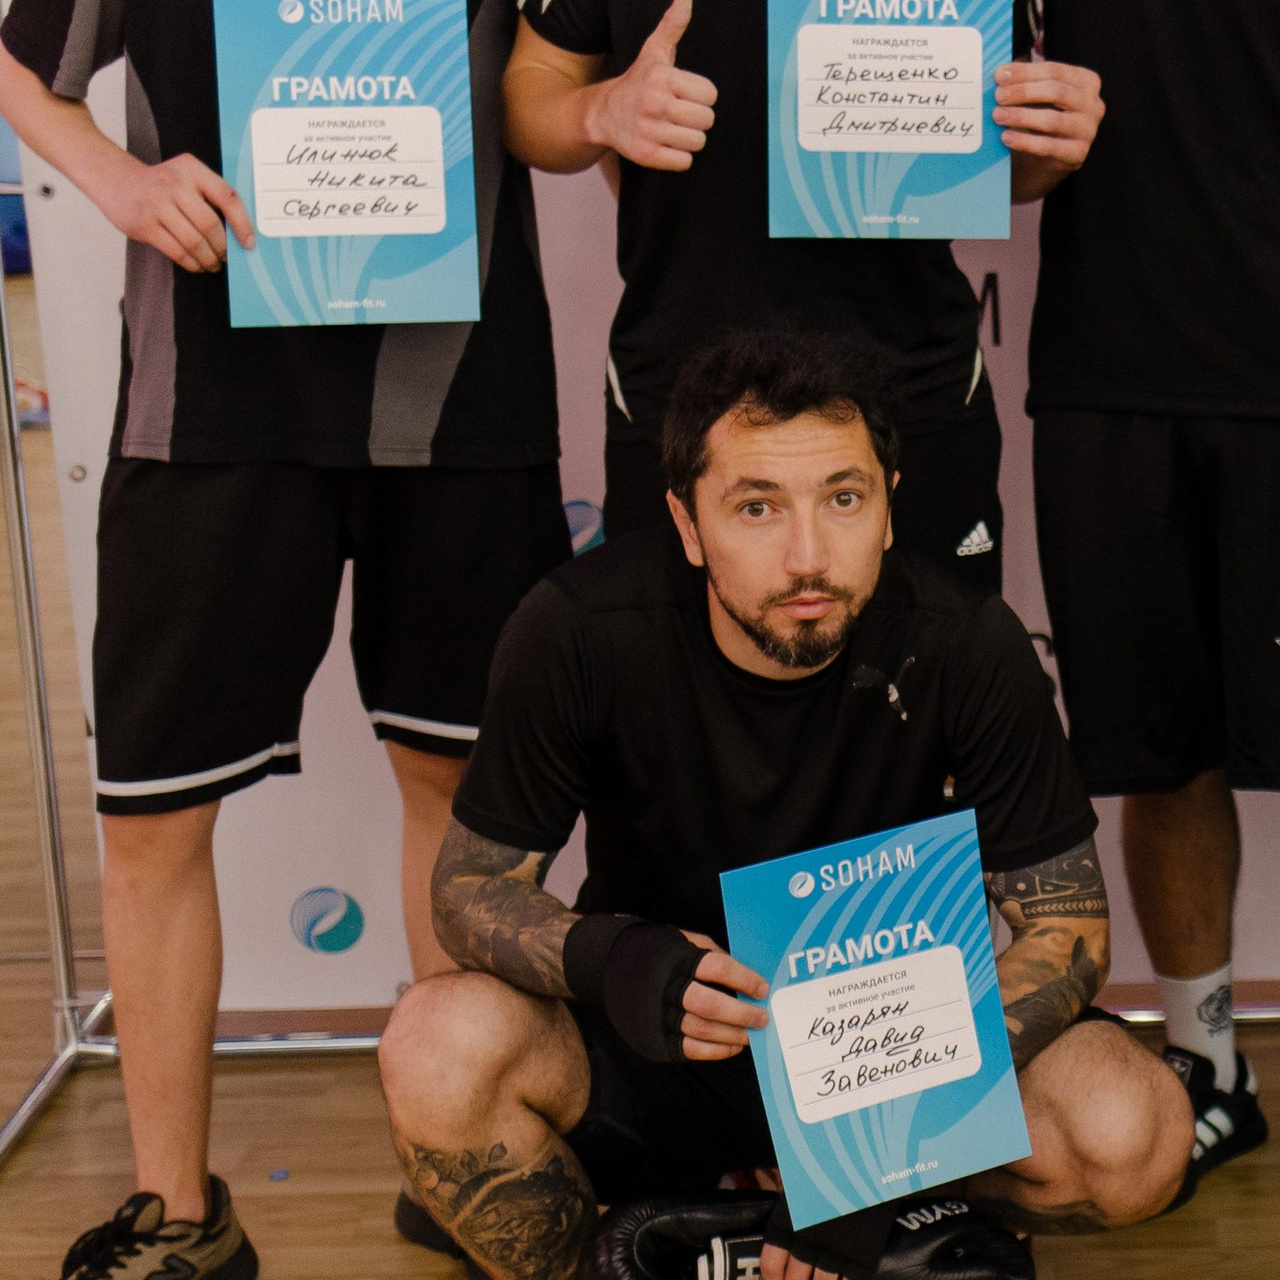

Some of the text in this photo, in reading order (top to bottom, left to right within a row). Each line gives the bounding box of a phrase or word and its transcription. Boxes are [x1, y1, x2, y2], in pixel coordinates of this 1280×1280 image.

[852, 38, 928, 48] НАГРАЖДАЕТСЯ
[823, 62, 959, 83] Терещенко
[272, 76, 416, 101] ГРАМОТА
[308, 119, 386, 129] НАГРАЖДАЕТСЯ
[308, 172, 427, 187] Никита
[283, 198, 418, 218] Сергеевич
[819, 843, 916, 892] SOHAM
[788, 920, 935, 979] ГРАМОТА
[828, 970, 908, 998] НАГРАЖДАЕТСЯ
[826, 983, 916, 1014] за активное участие
[807, 1000, 909, 1041] Казарян
[816, 1044, 958, 1097] Завенович
[881, 1158, 938, 1185] soham-fit.ru
